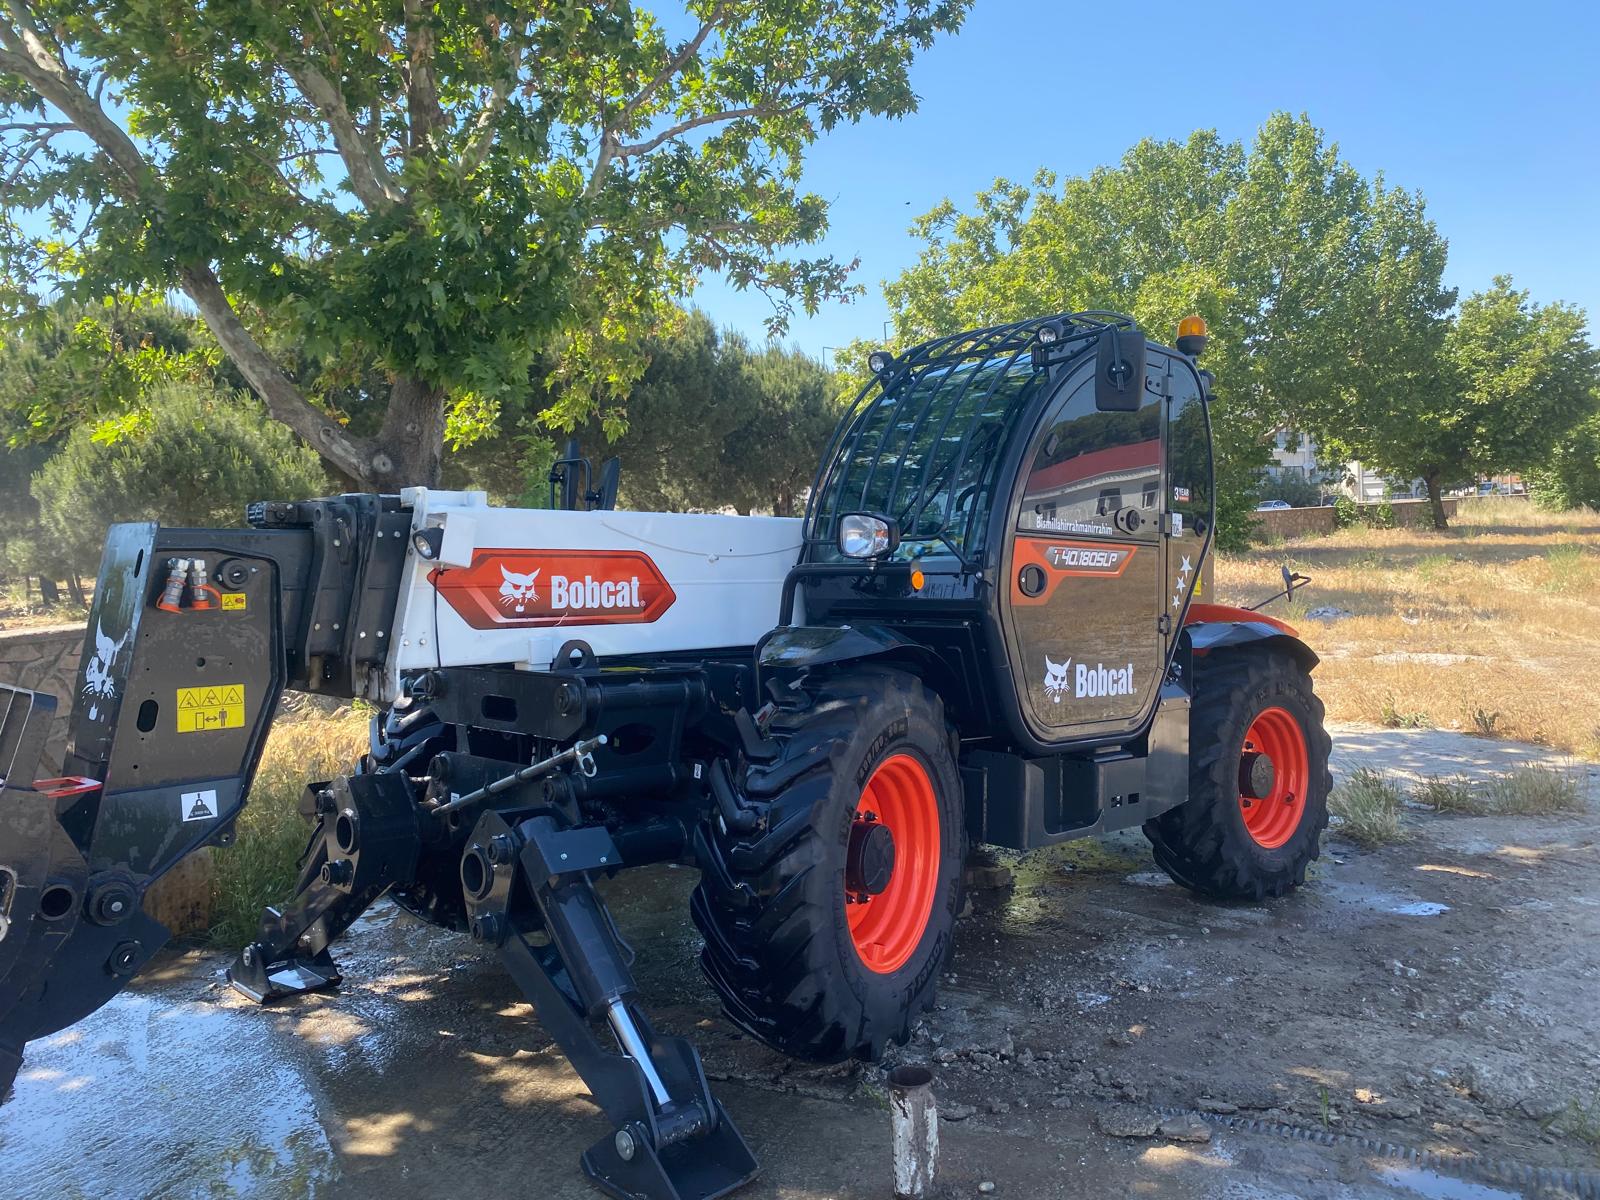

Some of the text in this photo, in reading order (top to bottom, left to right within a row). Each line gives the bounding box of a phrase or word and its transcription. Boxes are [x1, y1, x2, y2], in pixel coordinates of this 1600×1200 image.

[1174, 487, 1179, 500] 3
[1036, 516, 1113, 535] Bismillahirrahmanirrahim
[1054, 549, 1118, 567] T40.180SLP
[551, 575, 640, 609] Bobcat
[1075, 663, 1134, 698] Bobcat
